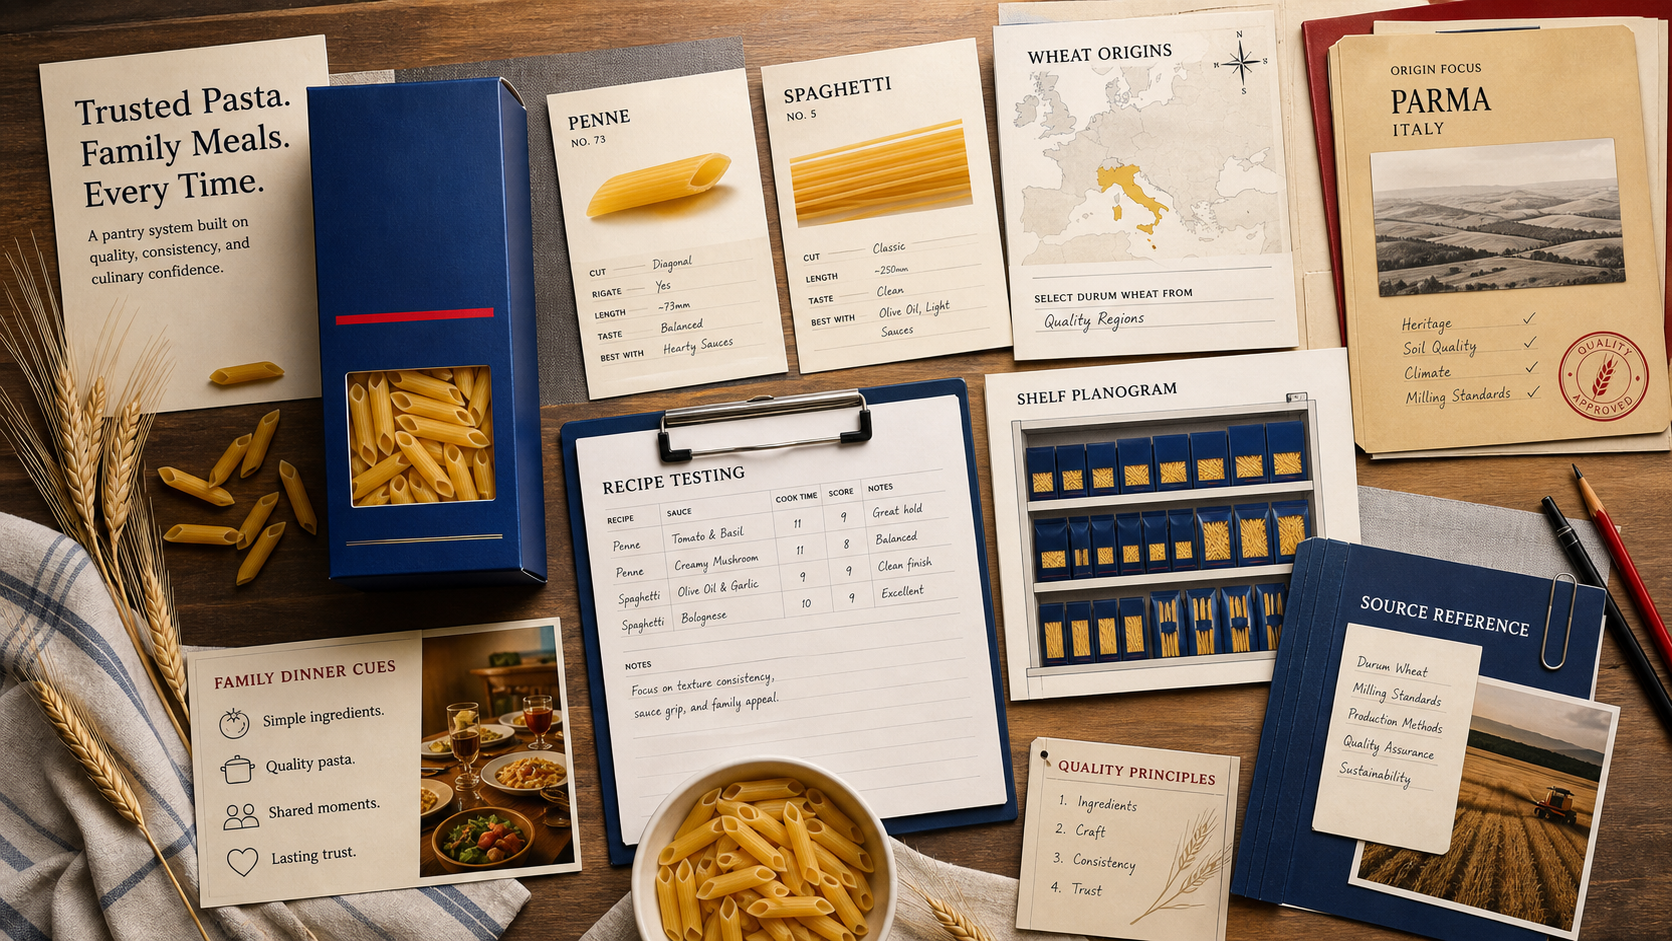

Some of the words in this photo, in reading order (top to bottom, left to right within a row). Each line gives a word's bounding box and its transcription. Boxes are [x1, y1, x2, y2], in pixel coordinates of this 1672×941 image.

[1236, 30, 1242, 38] N
[1028, 48, 1092, 64] WHEAT
[1098, 43, 1172, 60] ORIGINS
[1390, 64, 1436, 76] ORIGIN
[1441, 63, 1482, 74] FOCUS
[784, 76, 892, 104] SPAGHETTI
[1391, 86, 1492, 114] PARMA
[75, 89, 192, 126] Trusted
[202, 86, 291, 114] Pasta.
[787, 112, 806, 122] NO.
[810, 109, 817, 119] 5
[568, 109, 631, 130] PENNE
[1393, 122, 1444, 137] ITALY
[81, 133, 182, 167] Family
[191, 123, 290, 156] Meals.
[571, 137, 591, 148] NO.
[594, 135, 606, 144] 73
[84, 180, 169, 210] Every
[178, 172, 264, 199] Time.
[88, 230, 98, 242] A
[102, 227, 145, 244] pantry
[149, 221, 193, 236] system
[198, 218, 227, 232] built
[232, 218, 249, 228] on
[89, 250, 138, 266] quality,
[142, 241, 221, 258] consistency,
[226, 236, 250, 250] and
[803, 253, 820, 262] CUT
[873, 242, 906, 254] Classic
[91, 270, 144, 285] culinary
[148, 264, 224, 280] confidence.
[589, 268, 606, 277] CUT
[652, 255, 693, 273] Diagonal
[592, 287, 622, 298] RIGATE
[656, 280, 671, 293] Yes
[806, 273, 838, 284] LENGTH
[808, 295, 833, 304] TASTE
[877, 286, 904, 297] Clean
[1034, 294, 1073, 304] SELECT
[1077, 291, 1117, 302] DURUM
[1121, 289, 1159, 299] WHEAT
[1162, 289, 1193, 297] FROM
[595, 309, 626, 320] LENGTH
[811, 316, 830, 326] BEST
[834, 314, 855, 323] WITH
[879, 307, 902, 319] Olive
[906, 303, 922, 316] Oil,
[926, 300, 950, 317] Light
[1044, 314, 1091, 333] Quality
[1098, 311, 1144, 331] Regions
[598, 331, 622, 340] TASTE
[660, 318, 703, 333] Balanced
[881, 326, 914, 338] Sauces
[1402, 317, 1452, 335] Heritage
[600, 353, 619, 362] BEST
[623, 350, 644, 359] WITH
[664, 342, 696, 355] Hearty
[701, 337, 734, 349] Sauces
[1403, 340, 1426, 355] Soil
[1431, 339, 1477, 357] Quality
[1577, 339, 1632, 356] QUALITY
[1404, 365, 1451, 380] Climate
[1017, 390, 1066, 406] SHELF
[1072, 382, 1177, 402] PLANOGRAM
[1405, 391, 1446, 410] Milling
[1452, 388, 1511, 403] Standards
[1573, 394, 1633, 415] APPROVED
[602, 475, 665, 495] RECIPE
[670, 466, 746, 488] TESTING
[607, 514, 634, 524] RECIPE
[667, 508, 692, 517] SAUCE
[776, 494, 798, 503] COOK
[800, 492, 818, 501] TIME
[828, 487, 854, 497] SCORE
[868, 482, 893, 492] NOTES
[613, 540, 641, 552] Penne
[672, 532, 706, 545] Tomato
[708, 529, 717, 540] &
[720, 526, 745, 539] Basil
[794, 519, 802, 529] 11
[840, 512, 847, 522] 9
[872, 505, 900, 518] Great
[903, 503, 923, 514] hold
[615, 566, 644, 578] Penne
[674, 559, 709, 573] Creamy
[712, 553, 759, 567] Mushroom
[796, 545, 804, 555] 11
[843, 538, 850, 549] 8
[875, 531, 918, 545] Balanced
[618, 591, 661, 606] Spaghetti
[677, 585, 700, 598] Olive
[703, 582, 718, 594] Oil
[720, 582, 728, 592] &
[731, 579, 760, 591] Garlic
[800, 572, 806, 582] 9
[846, 566, 852, 577] 9
[878, 560, 903, 572] Clean
[907, 556, 932, 571] finish
[622, 617, 665, 633] Spaghetti
[681, 610, 728, 627] Bolognese
[802, 598, 812, 609] 10
[849, 592, 855, 603] 9
[881, 584, 924, 599] Excellent
[1361, 595, 1428, 620] SOURCE
[1433, 608, 1529, 637] REFERENCE
[214, 672, 275, 690] FAMILY
[281, 665, 346, 683] DINNER
[353, 660, 396, 675] CUES
[625, 660, 652, 670] NOTES
[1357, 656, 1390, 671] Durum
[1396, 663, 1428, 678] Wheat
[632, 684, 658, 696] Focus
[662, 683, 673, 692] on
[677, 678, 712, 691] texture
[716, 672, 775, 688] consistency,
[1352, 682, 1387, 704] Milling
[1392, 687, 1442, 707] Standards
[634, 707, 662, 719] sauce
[665, 704, 686, 718] grip,
[691, 701, 708, 712] and
[712, 697, 742, 712] family
[745, 692, 779, 707] appeal.
[263, 712, 306, 729] Simple
[310, 706, 385, 725] ingredients.
[1348, 708, 1397, 726] Production
[1402, 718, 1443, 734] Methods
[1343, 735, 1379, 757] Quality
[1384, 741, 1434, 760] Assurance
[266, 758, 314, 775] Quality
[318, 754, 355, 771] pasta.
[1058, 760, 1124, 777] QUALITY
[1129, 767, 1216, 785] PRINCIPLES
[1339, 761, 1411, 790] Sustainability
[269, 803, 313, 819] Shared
[318, 798, 380, 814] moments.
[1060, 795, 1067, 806] 1.
[1078, 796, 1137, 814] Ingredients
[1055, 824, 1066, 834] 2.
[1076, 824, 1106, 840] Craft
[272, 850, 319, 865] Lasting
[323, 847, 356, 860] trust.
[1053, 853, 1063, 864] 3.
[1073, 853, 1136, 876] Consistency
[1051, 882, 1061, 893] 4.
[1072, 883, 1102, 897] Trust
